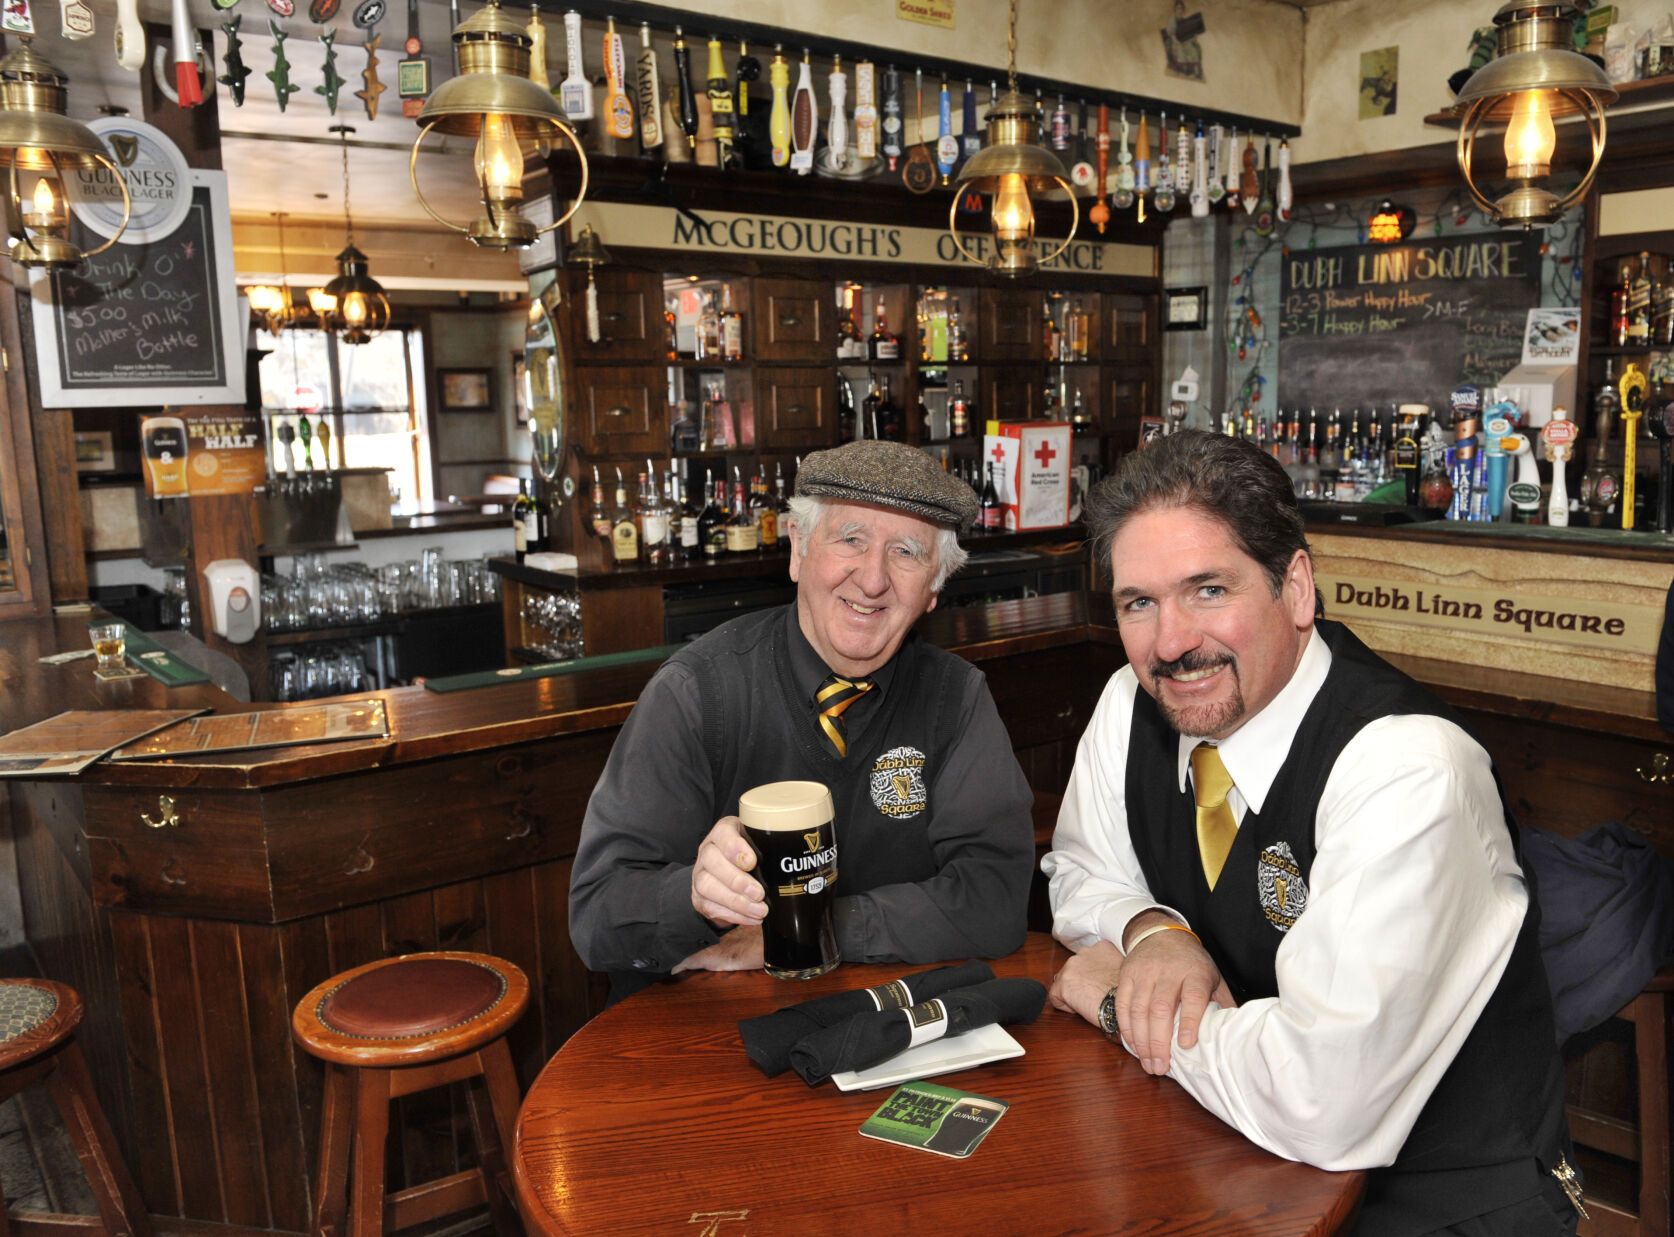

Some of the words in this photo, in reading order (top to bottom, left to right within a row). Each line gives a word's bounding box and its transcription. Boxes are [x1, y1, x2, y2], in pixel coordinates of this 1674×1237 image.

[637, 53, 655, 118] YARDS
[131, 188, 174, 199] LAGER
[936, 233, 990, 263] OFF
[1290, 256, 1342, 288] DUBH
[1357, 248, 1409, 284] LINN
[1414, 241, 1527, 280] SQUARE
[140, 281, 199, 313] Day
[136, 330, 199, 361] Bottle
[188, 423, 243, 438] HALF
[205, 434, 258, 449] HALF
[1459, 463, 1471, 512] LAGER
[1335, 582, 1410, 610] Dubh
[1493, 599, 1625, 636] Square
[780, 844, 838, 873] GUINNESS
[891, 1091, 954, 1112] PAINT
[877, 1106, 935, 1129] BLACK
[953, 1111, 990, 1124] GUINNESS
